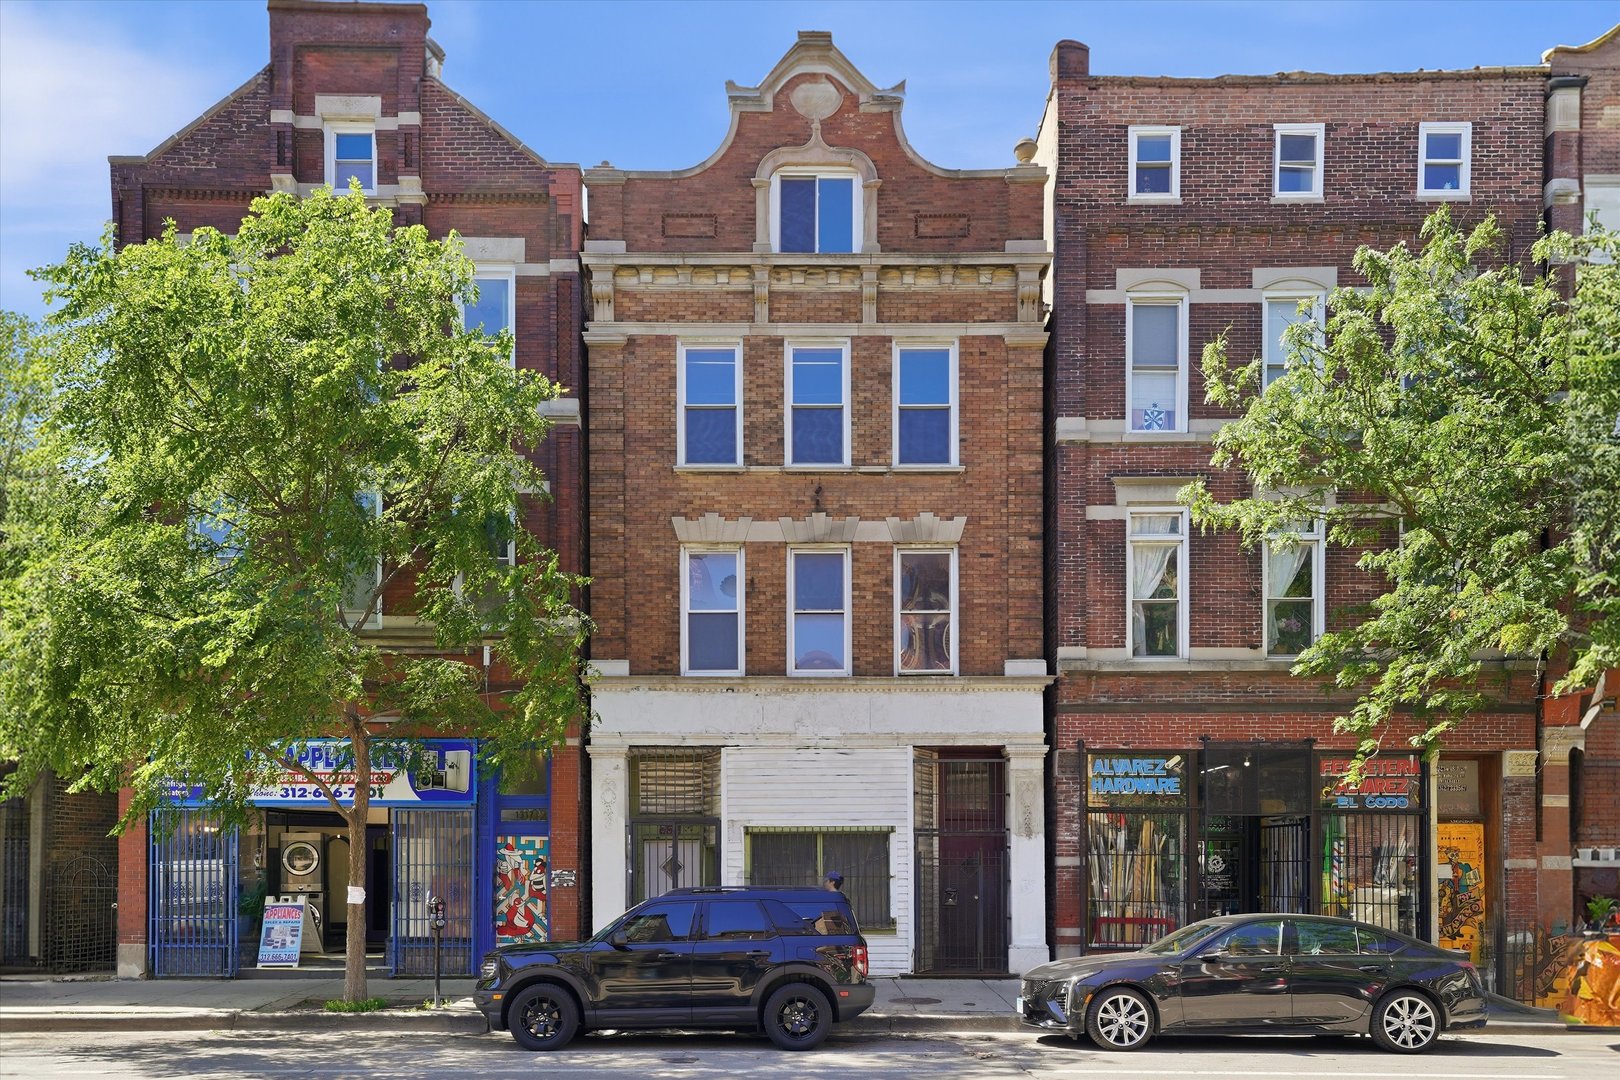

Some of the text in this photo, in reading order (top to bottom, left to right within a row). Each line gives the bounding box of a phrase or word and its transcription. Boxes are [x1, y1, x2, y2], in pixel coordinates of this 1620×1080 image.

[1093, 759, 1167, 775] ALVAREZ
[1092, 777, 1181, 794] HARDWARE
[1337, 796, 1359, 808] EL
[265, 907, 302, 920] APPLIANCES
